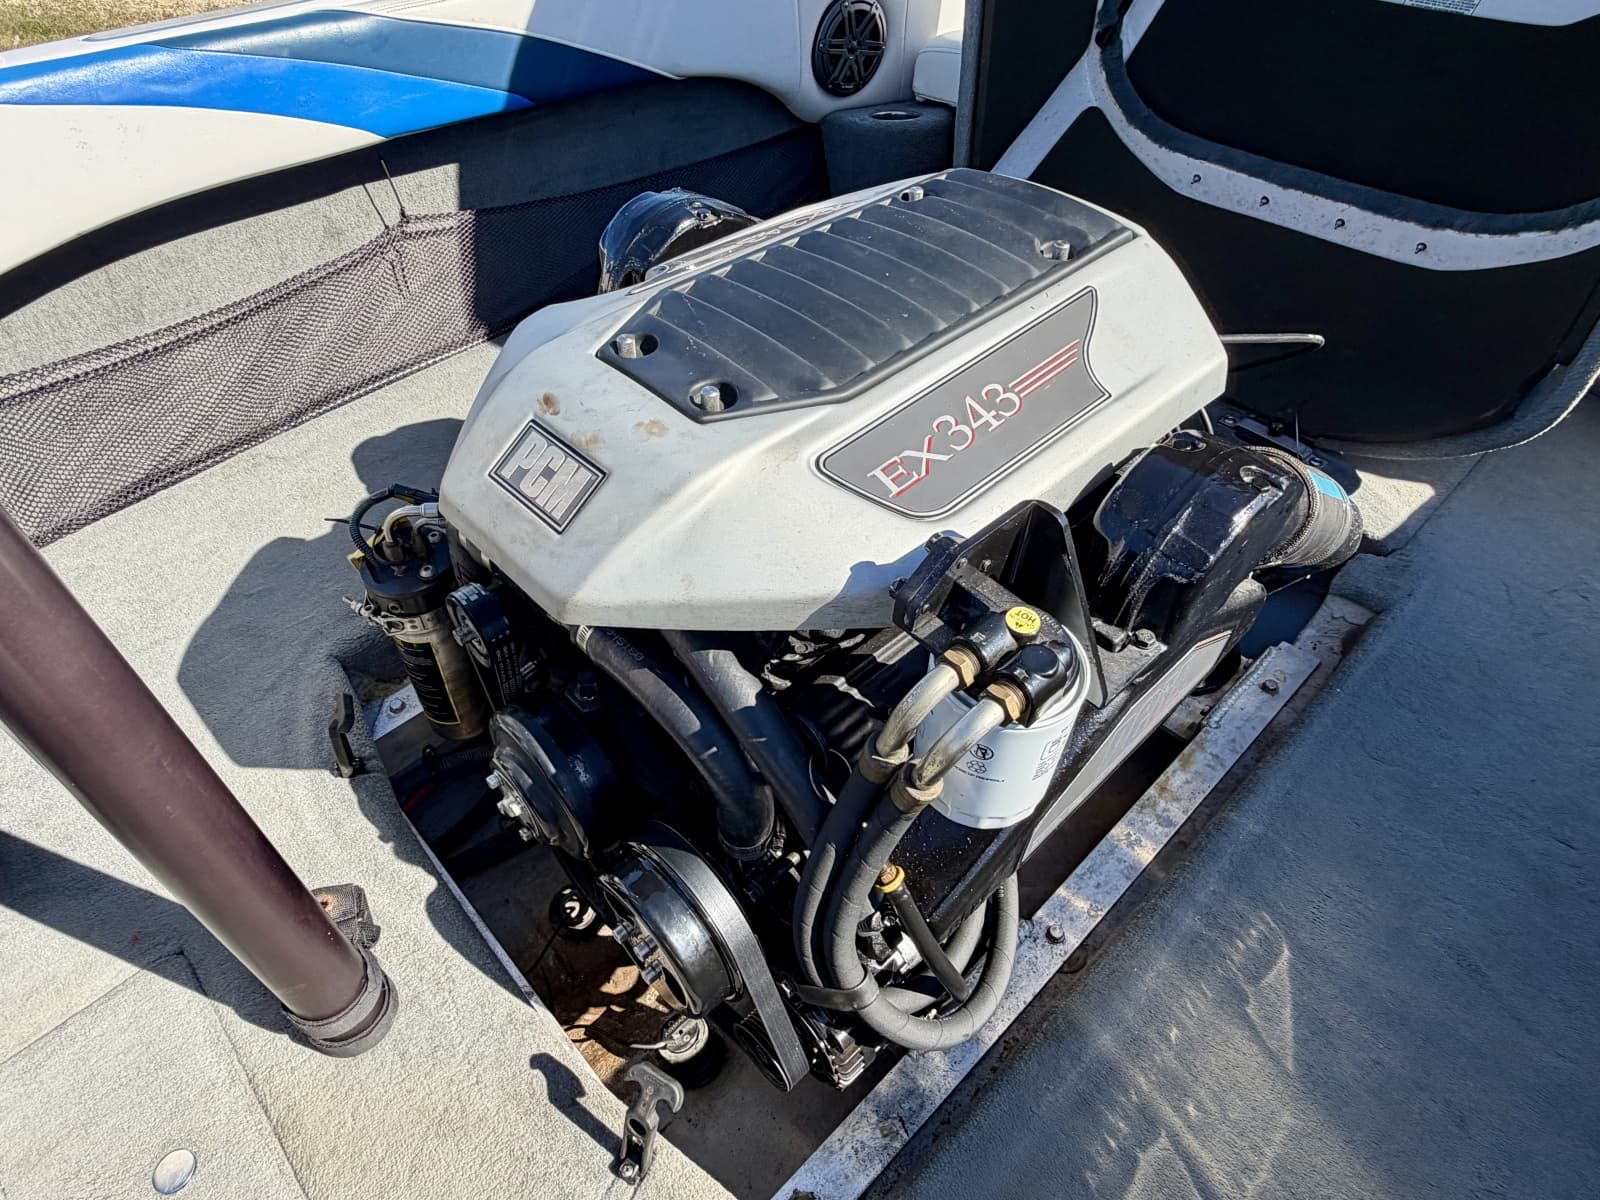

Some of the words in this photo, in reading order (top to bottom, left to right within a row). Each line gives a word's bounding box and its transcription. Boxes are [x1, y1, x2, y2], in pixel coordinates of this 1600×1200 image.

[500, 430, 594, 521] PCM
[866, 383, 1024, 498] EX343
[1014, 609, 1037, 625] HOT
